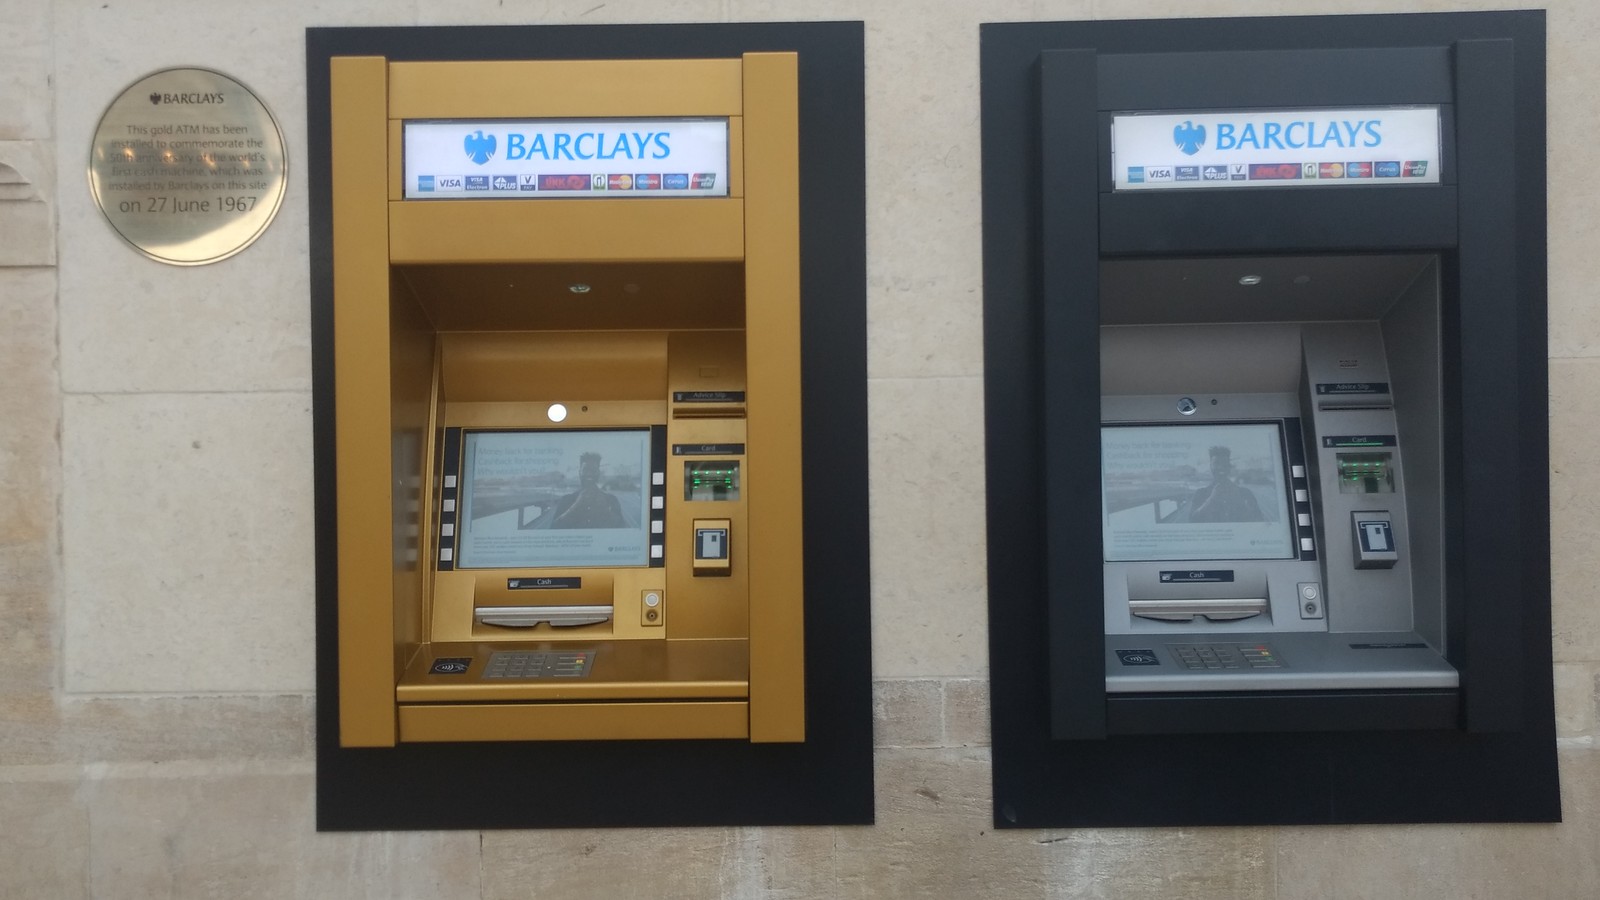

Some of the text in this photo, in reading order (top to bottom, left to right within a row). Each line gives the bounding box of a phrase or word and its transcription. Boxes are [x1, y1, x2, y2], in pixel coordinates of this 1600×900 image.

[163, 93, 225, 104] BARCLAYS
[126, 124, 248, 137] This gold ATM has been
[1216, 121, 1382, 150] BARCLAYS
[111, 138, 263, 149] installed to commemorate the
[506, 132, 670, 160] BARCLAYS
[134, 152, 194, 165] anniversary
[210, 152, 226, 162] the
[228, 152, 266, 162] world's
[112, 166, 263, 177] first cash machine, which was
[1149, 170, 1171, 178] VISA
[1209, 172, 1227, 180] PLUS
[108, 180, 268, 192] installed by Barclays on this site
[440, 179, 461, 188] VISA
[499, 182, 517, 190] PLUS
[119, 196, 258, 214] on 27 June 1967
